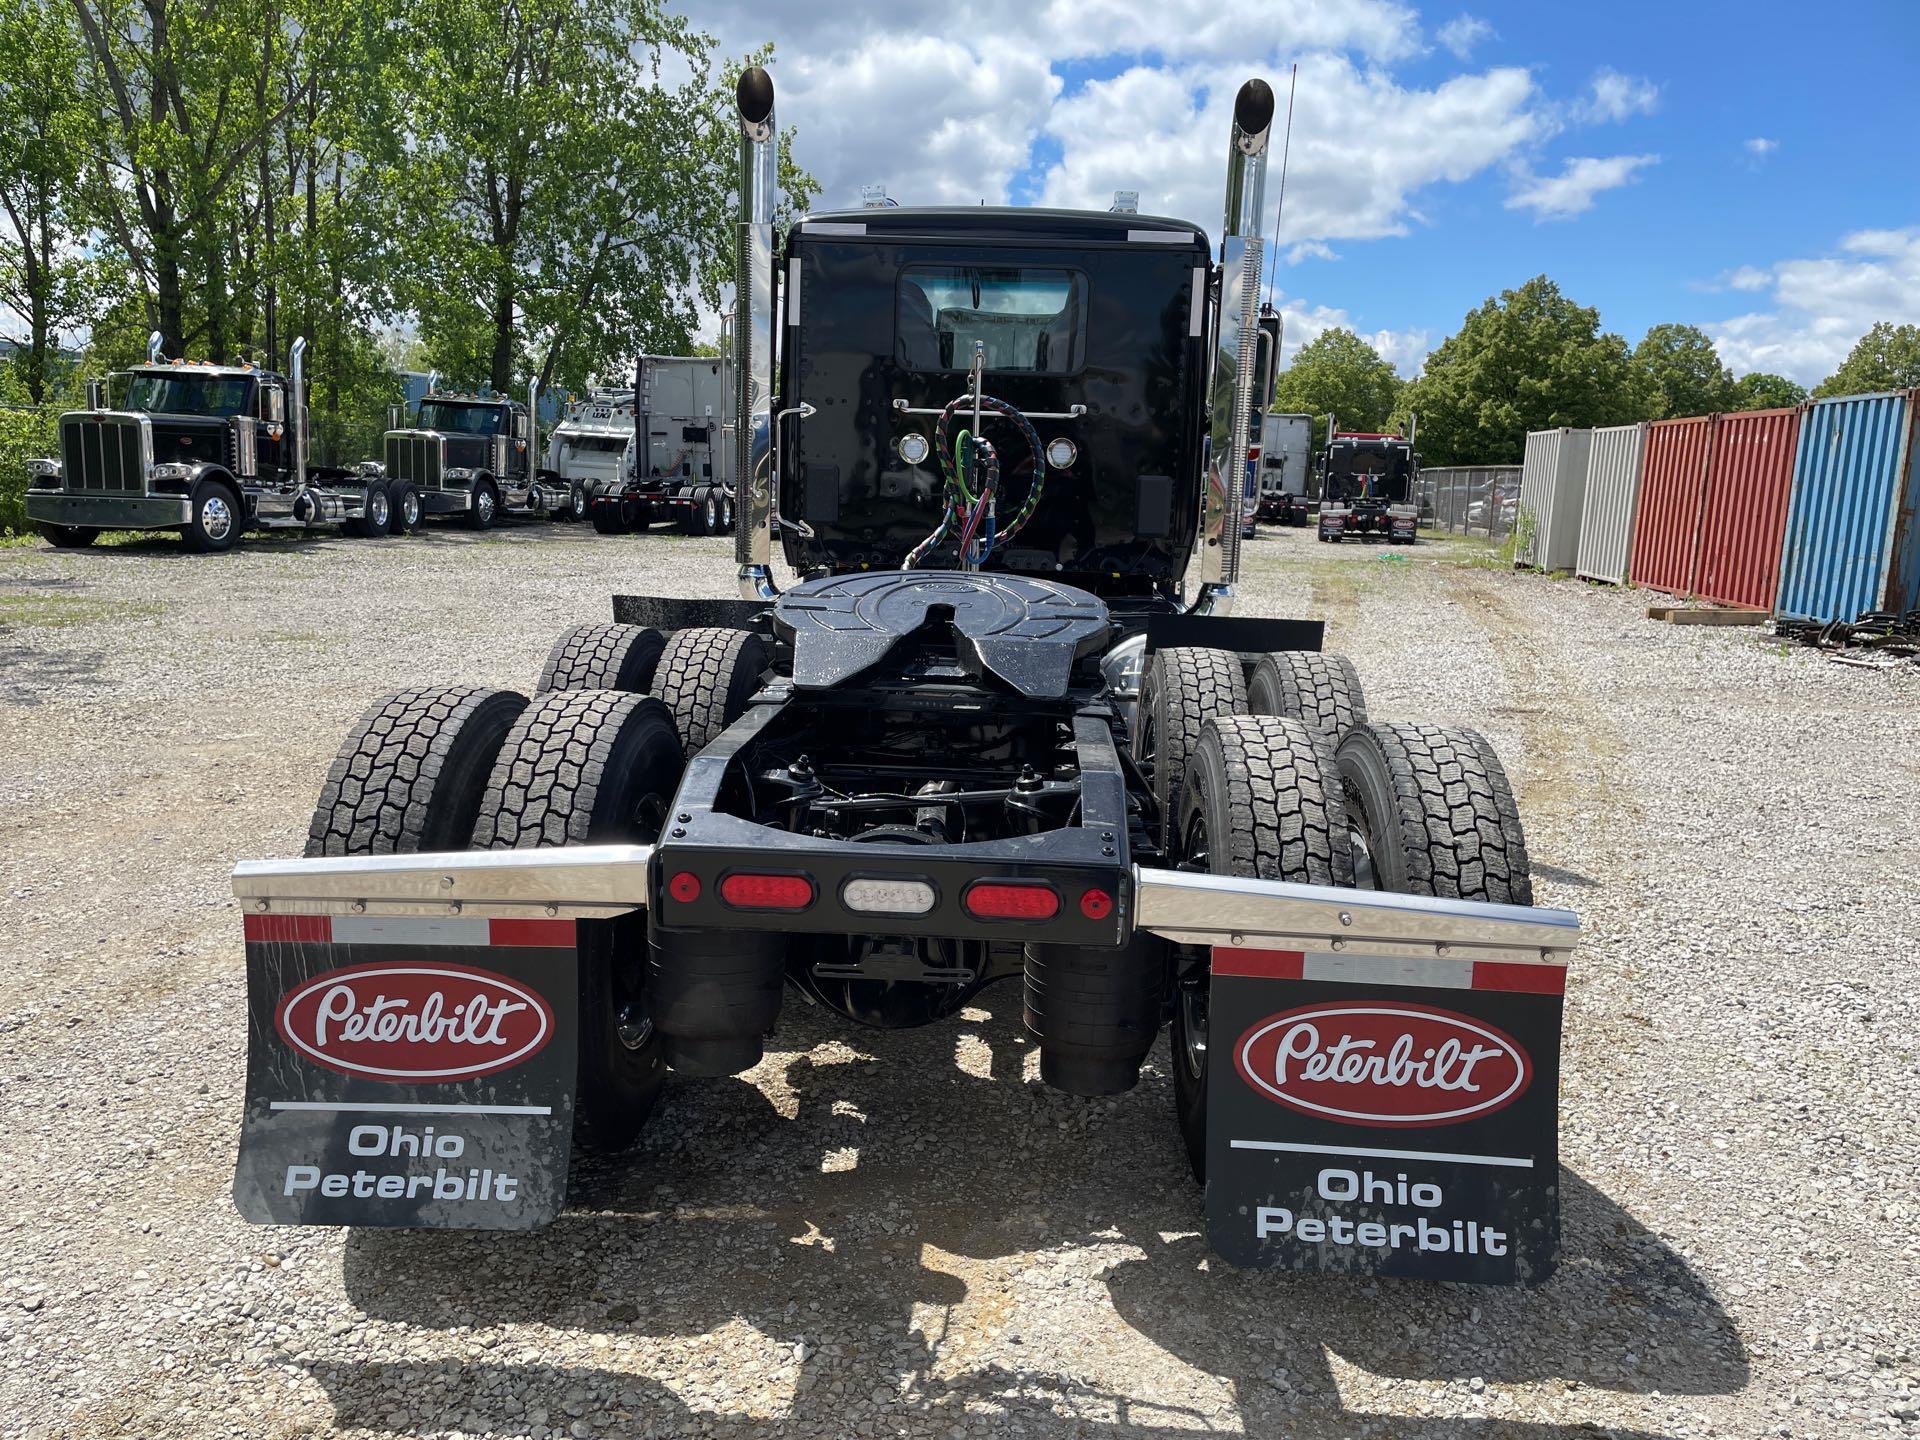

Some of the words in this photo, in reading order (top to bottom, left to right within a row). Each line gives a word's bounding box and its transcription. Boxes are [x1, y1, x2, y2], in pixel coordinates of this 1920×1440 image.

[316, 985, 526, 1046] Peterbilt
[1276, 1023, 1503, 1092] Peterbilt
[348, 1125, 465, 1158] Ohio
[283, 1165, 518, 1202] Peterbilt
[1317, 1168, 1443, 1208] Ohio
[1256, 1206, 1508, 1256] Peterbilt
